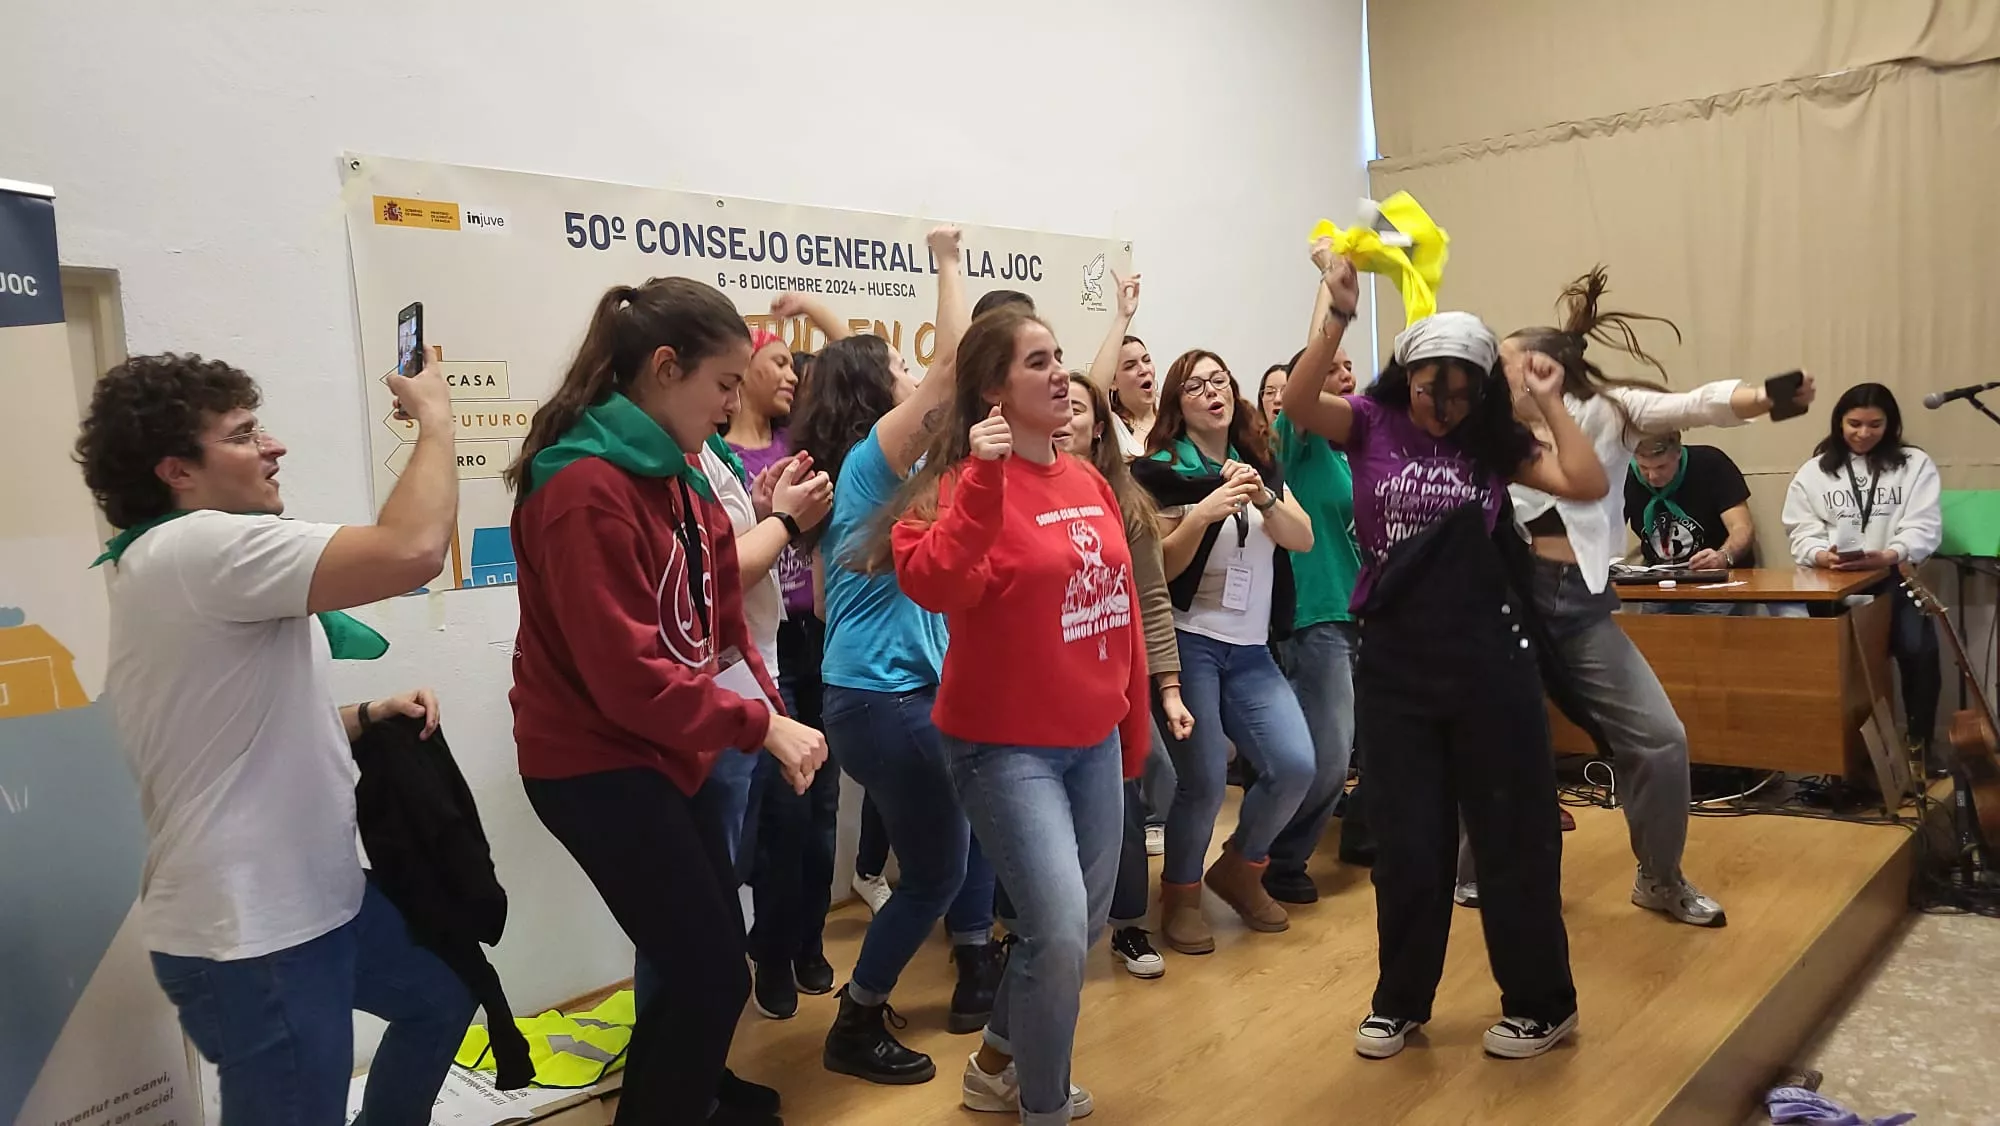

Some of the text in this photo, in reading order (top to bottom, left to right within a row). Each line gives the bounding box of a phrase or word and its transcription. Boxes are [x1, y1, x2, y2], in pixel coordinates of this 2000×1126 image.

[466, 211, 505, 228] injuve
[635, 218, 789, 264] CONSEJO
[795, 233, 923, 275] GENERAL
[966, 248, 996, 279] LA
[1001, 252, 1043, 282] JOC
[717, 272, 727, 288] 6
[739, 273, 748, 289] 8
[751, 274, 823, 294] DICIEMBRE
[825, 279, 857, 296] 2024
[868, 281, 917, 298] HUESCA
[446, 374, 496, 387] CASA
[457, 454, 487, 467] RRO
